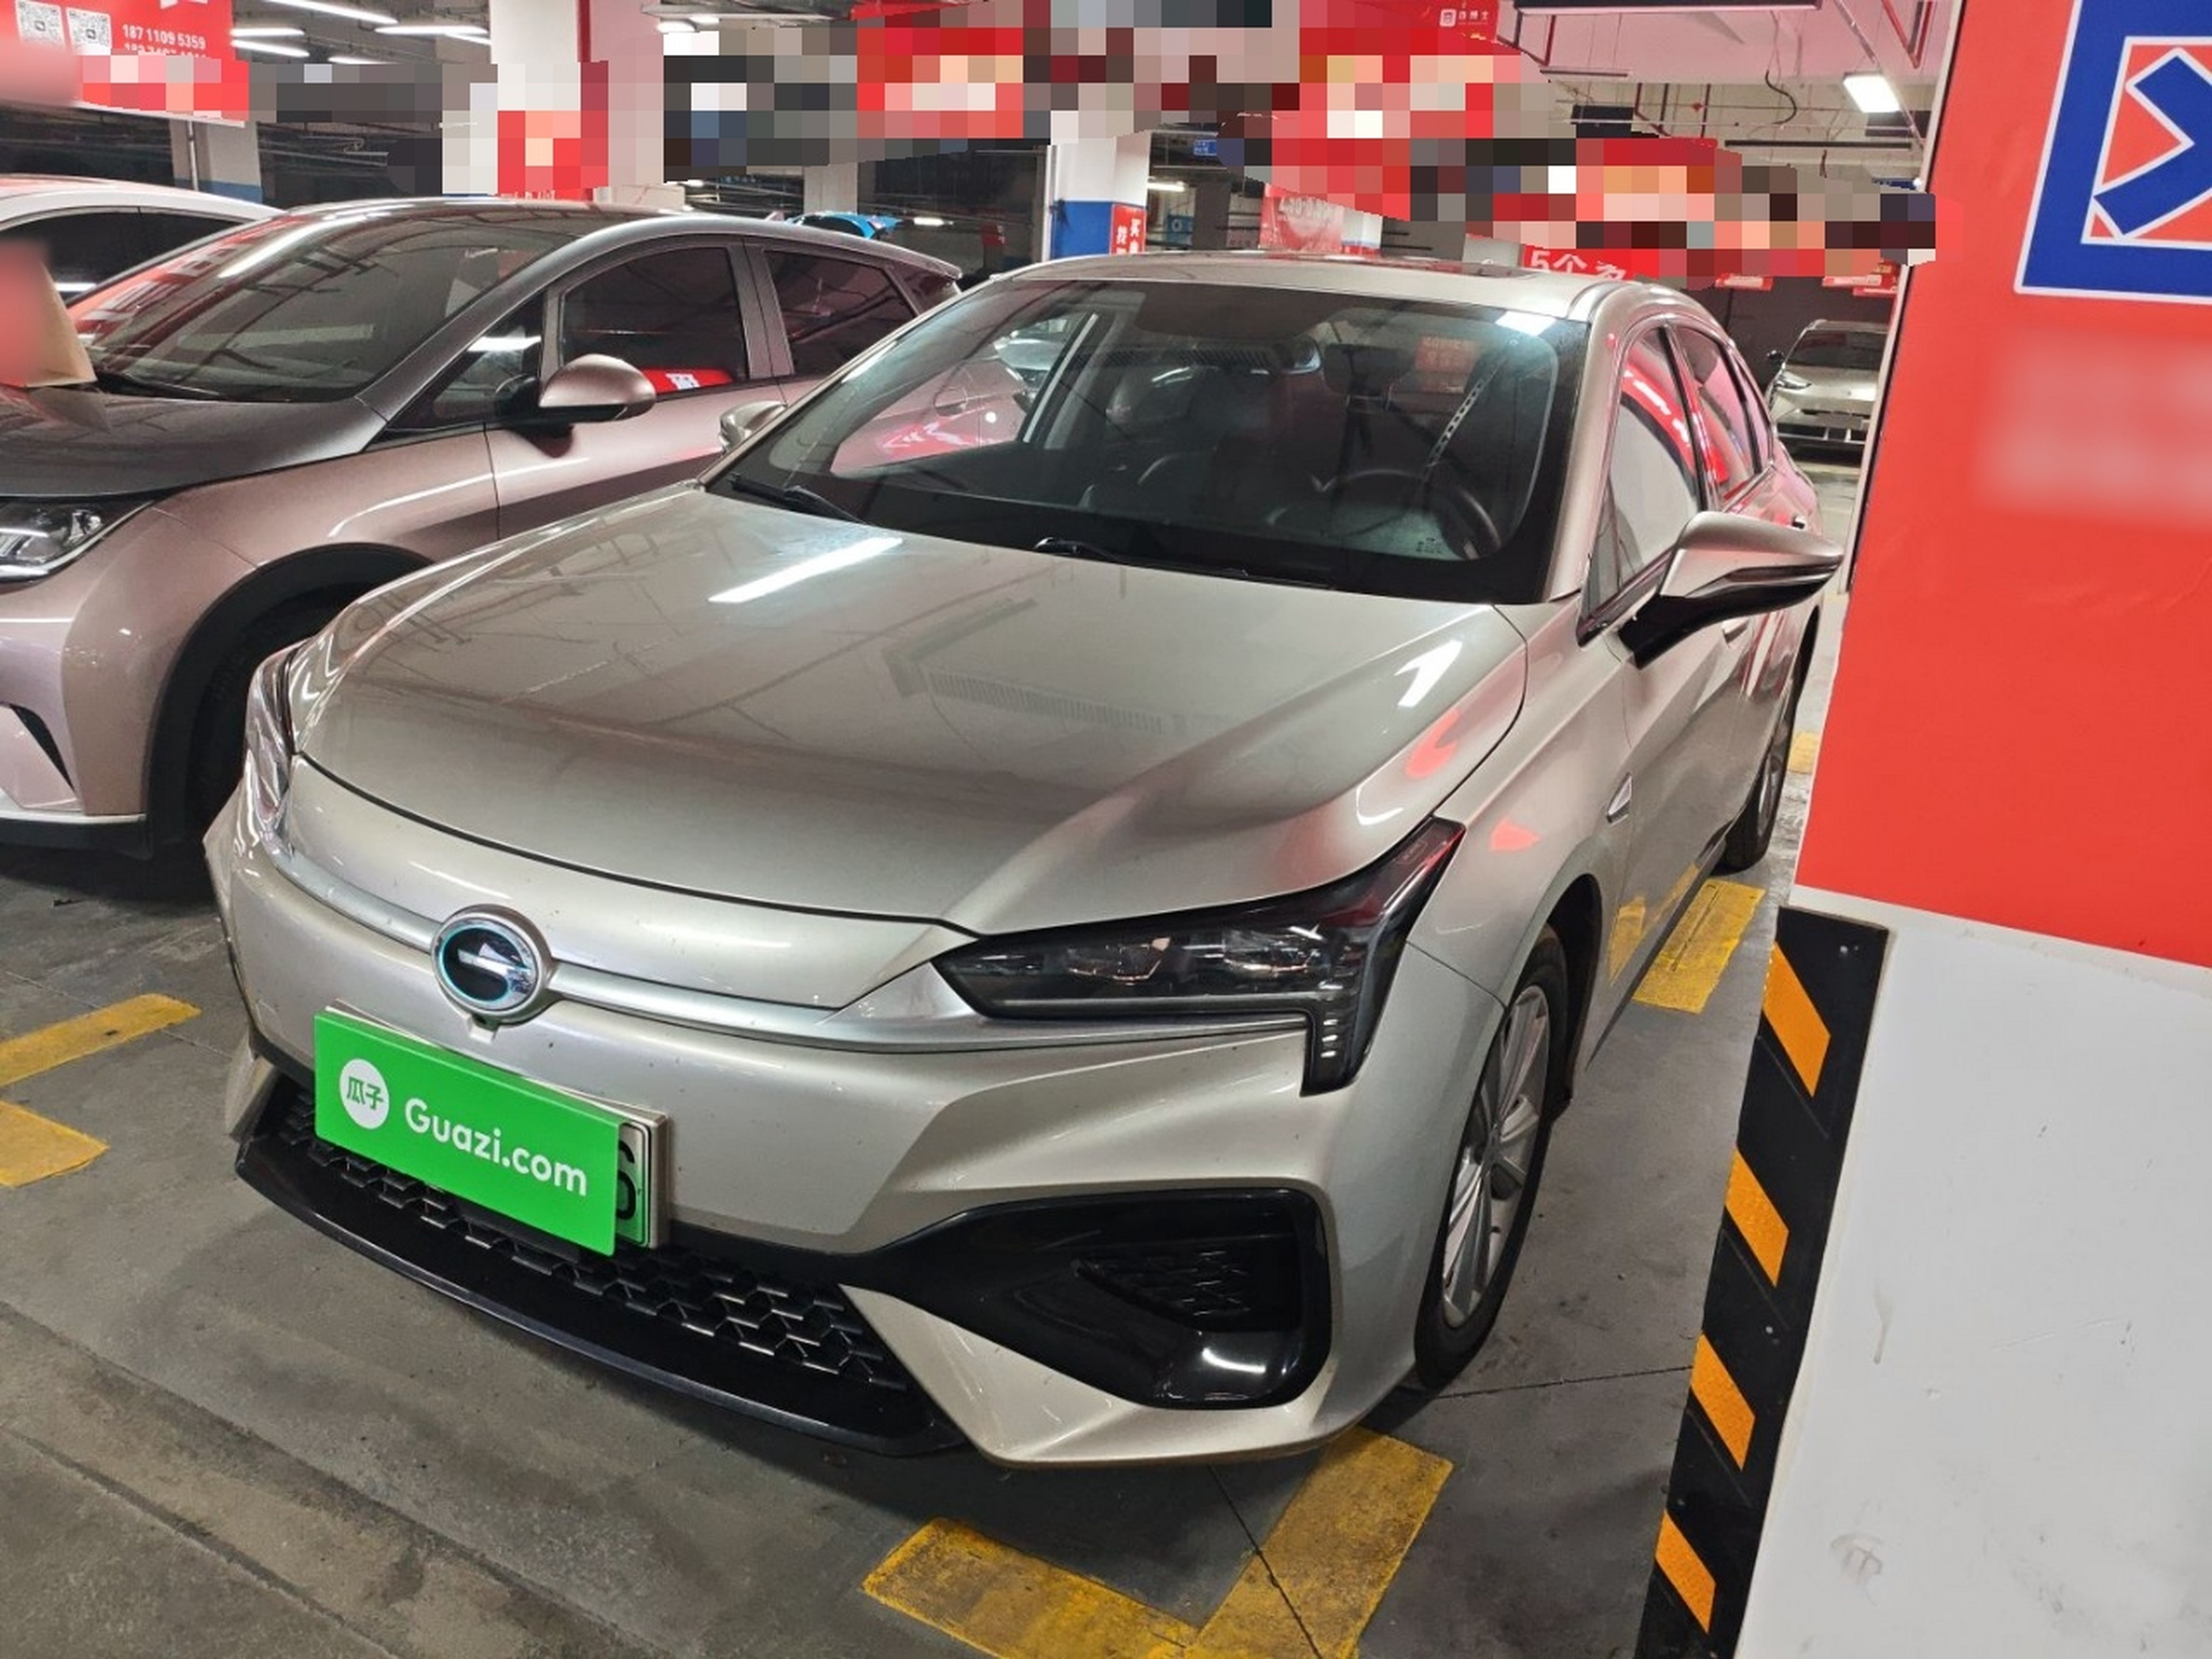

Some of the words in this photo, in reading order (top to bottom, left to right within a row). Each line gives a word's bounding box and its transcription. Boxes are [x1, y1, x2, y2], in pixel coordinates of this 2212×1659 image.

[122, 24, 143, 40] 187
[146, 28, 176, 46] 1109
[177, 32, 206, 50] 5359
